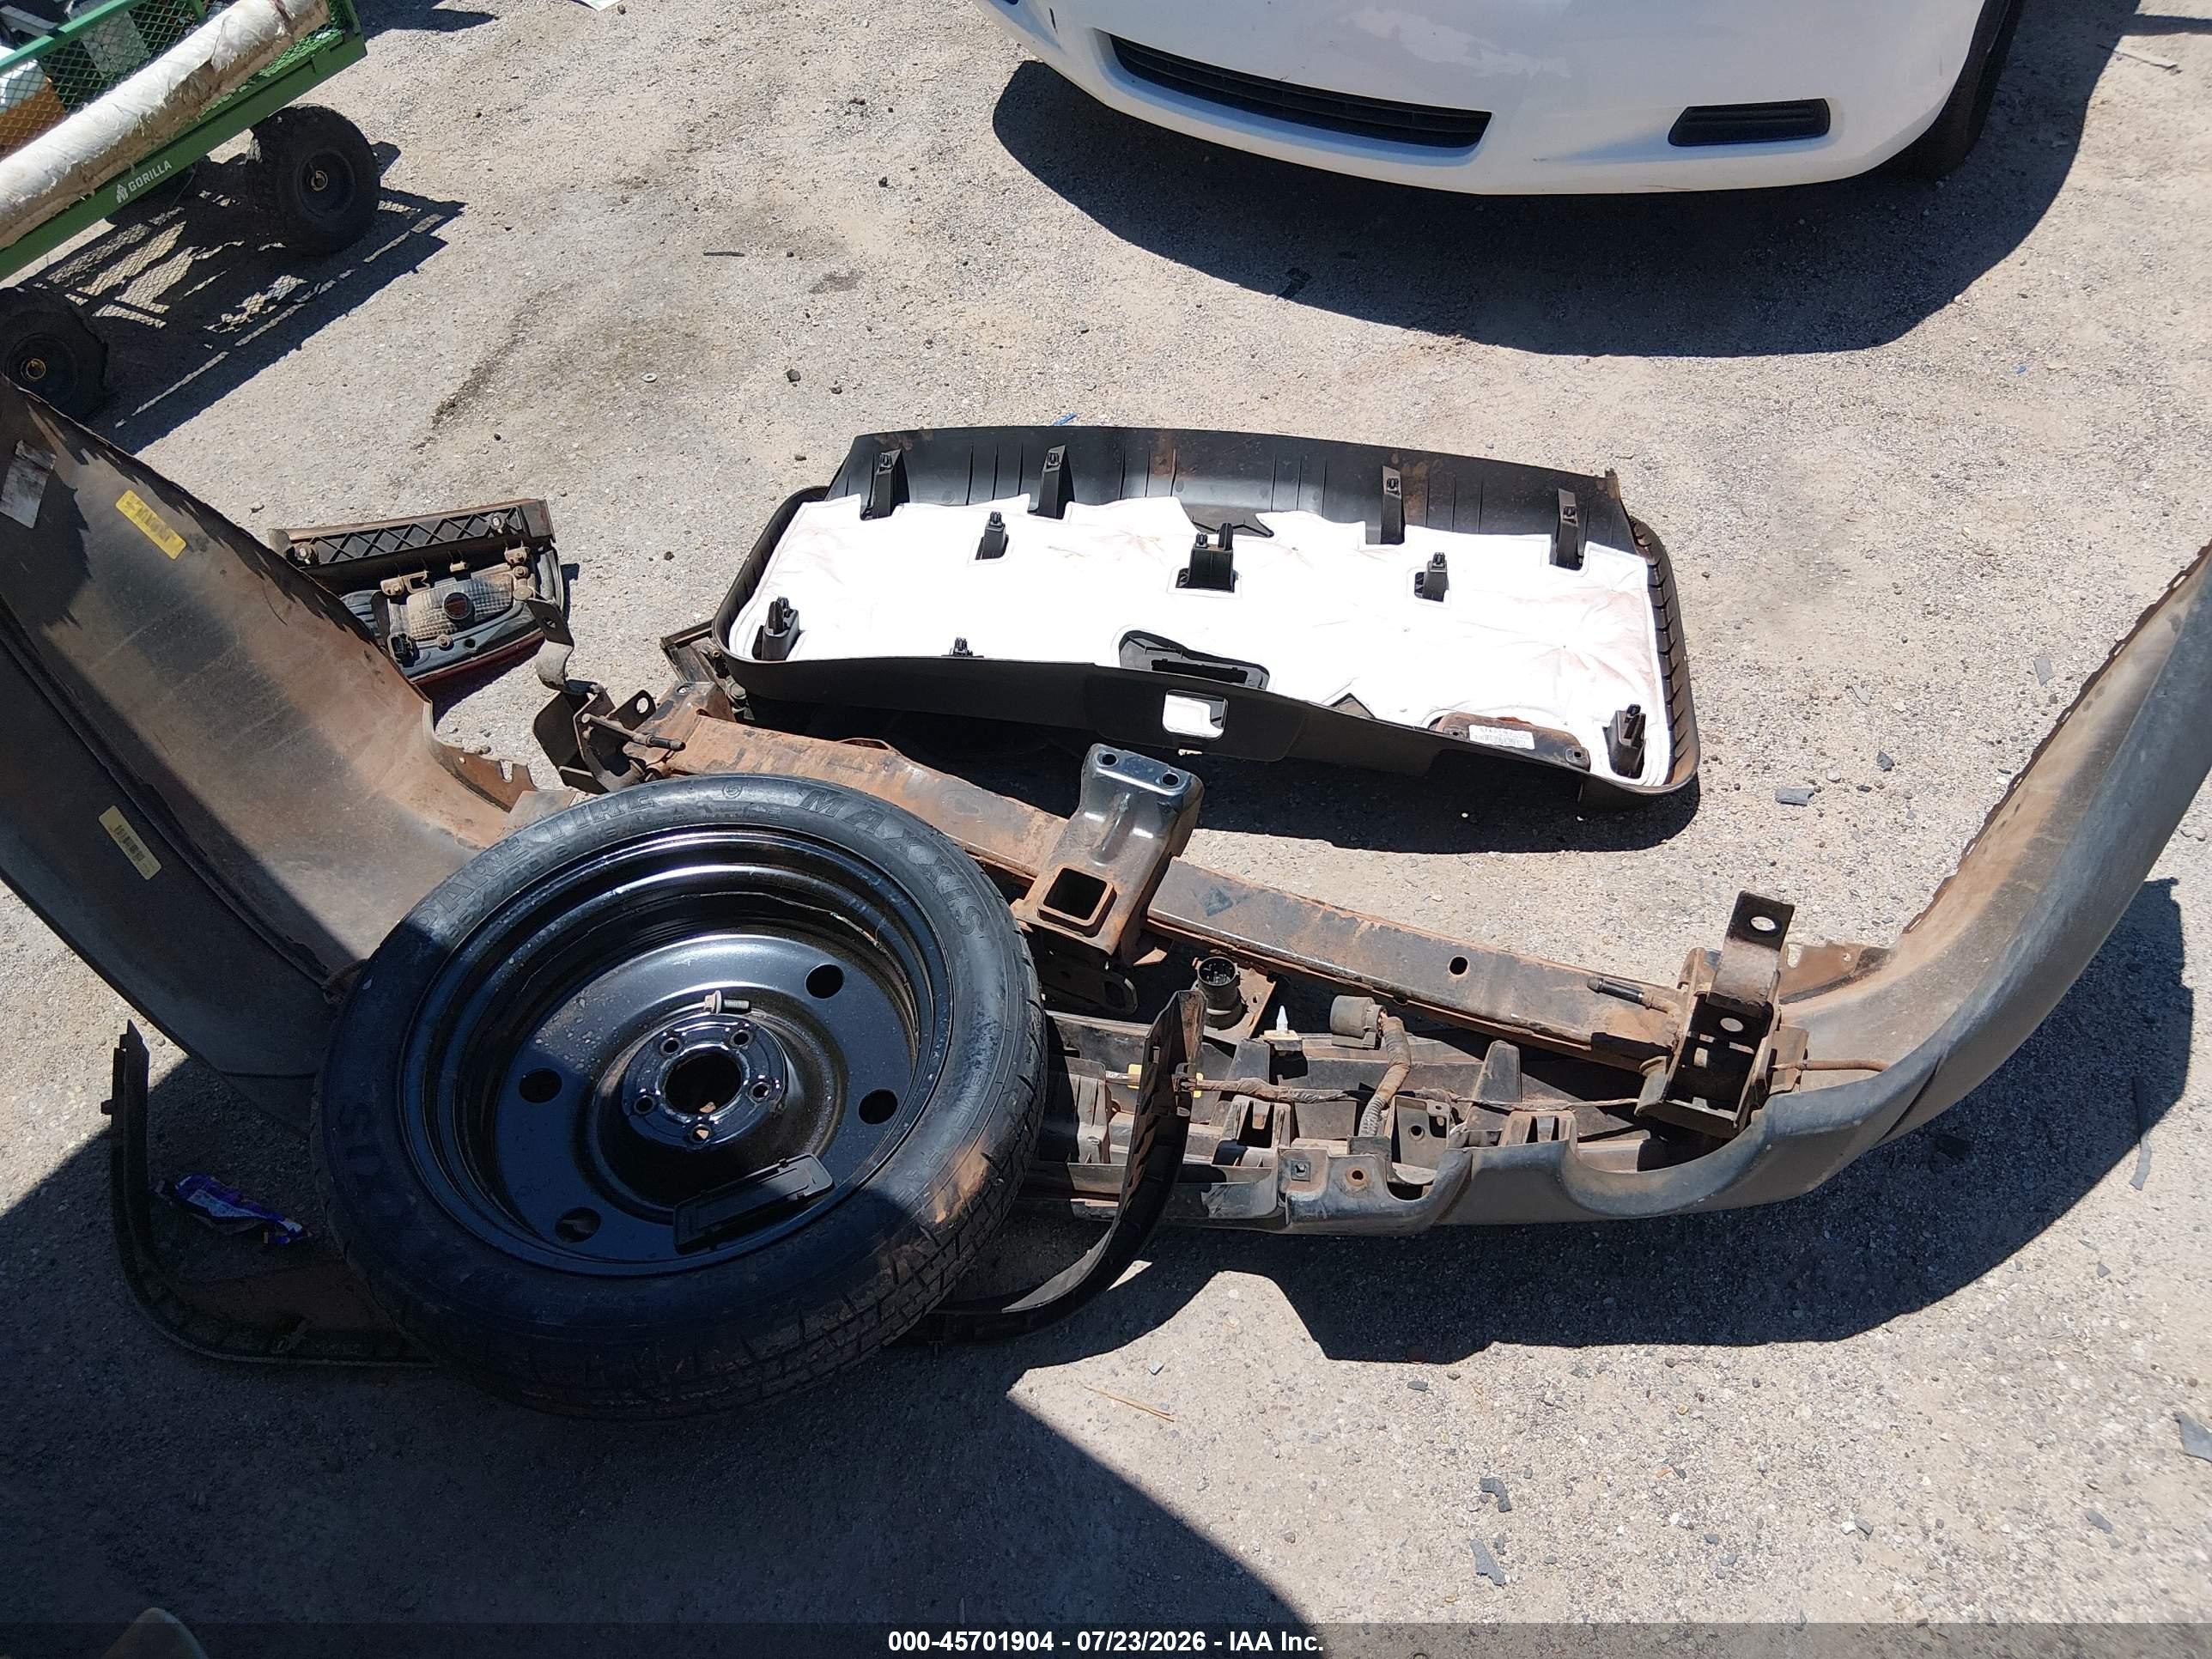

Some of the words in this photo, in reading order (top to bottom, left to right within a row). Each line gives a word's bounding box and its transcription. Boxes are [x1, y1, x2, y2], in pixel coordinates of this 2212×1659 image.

[128, 160, 172, 191] GORILLA
[414, 835, 532, 933] PARE
[533, 791, 655, 842] TIRE
[798, 789, 986, 936] MAXXIS
